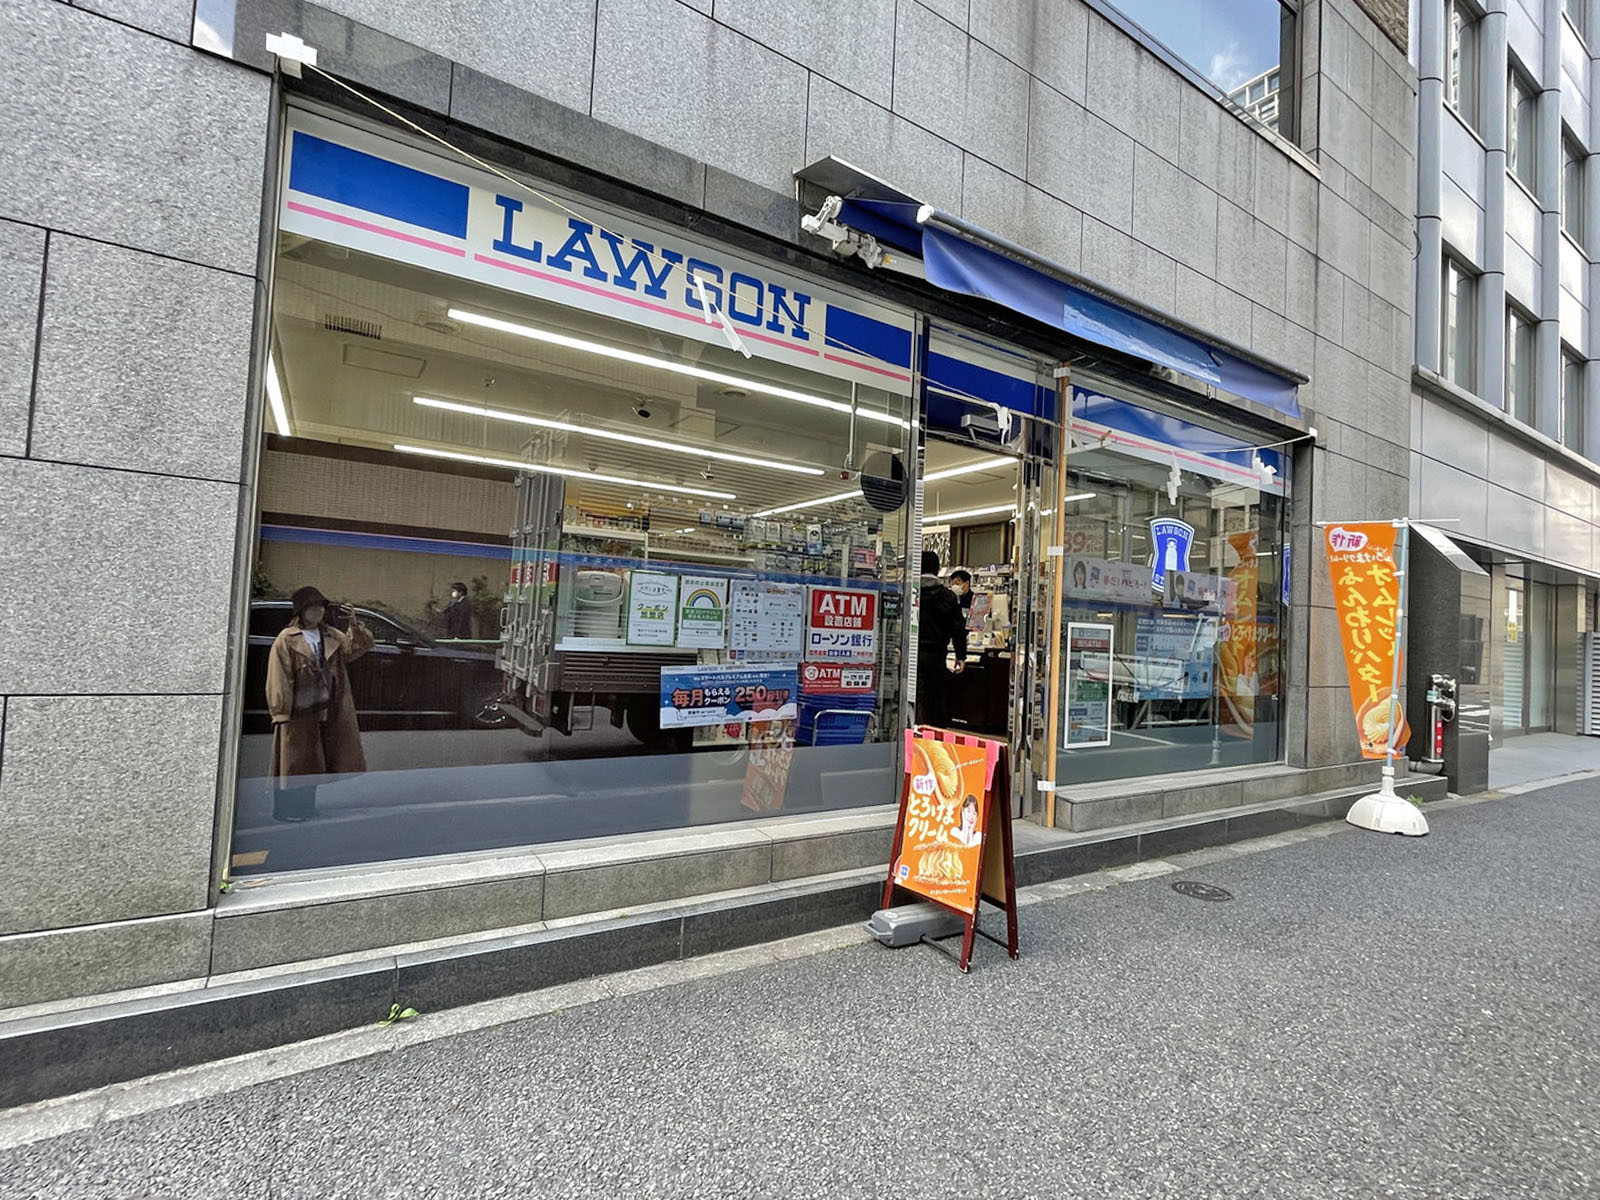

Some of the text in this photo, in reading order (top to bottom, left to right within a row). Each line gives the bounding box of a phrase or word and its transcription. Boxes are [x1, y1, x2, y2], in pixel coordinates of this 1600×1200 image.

[493, 194, 811, 341] LAWSON
[1156, 525, 1189, 540] LAWSON
[819, 593, 867, 616] ATM
[824, 615, 862, 628] 設置店舗
[812, 633, 873, 647] ローソン銀行
[819, 668, 840, 678] ATM
[674, 688, 703, 707] 毎月
[704, 687, 731, 696] もらえる
[704, 697, 731, 706] クーポン
[908, 817, 949, 842] クリーム
